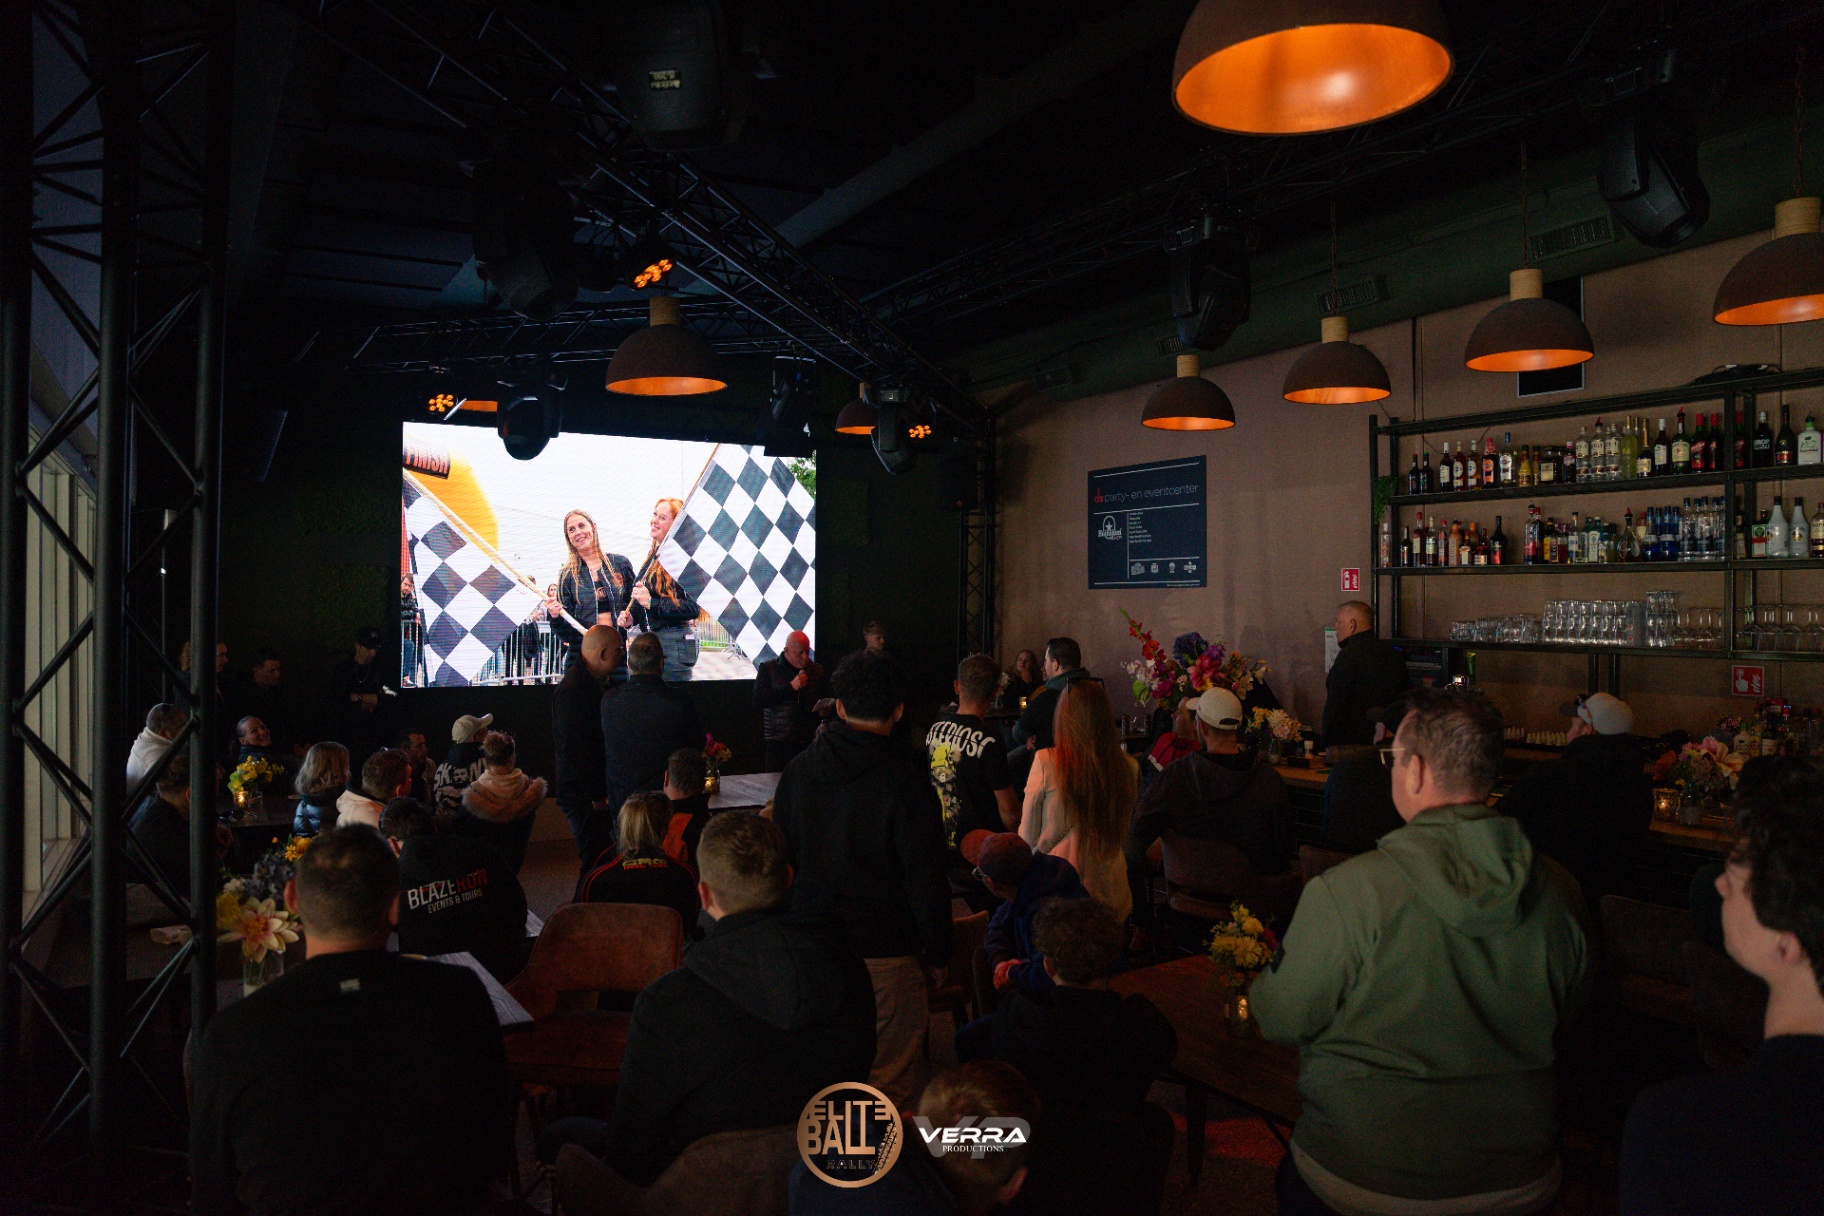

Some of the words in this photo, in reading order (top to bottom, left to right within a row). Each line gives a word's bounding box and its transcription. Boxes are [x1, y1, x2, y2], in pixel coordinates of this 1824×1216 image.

[1131, 490, 1143, 500] en
[1144, 484, 1199, 498] eventcenter
[427, 896, 454, 914] EVENTS
[455, 895, 461, 904] &
[461, 888, 483, 902] TOURS
